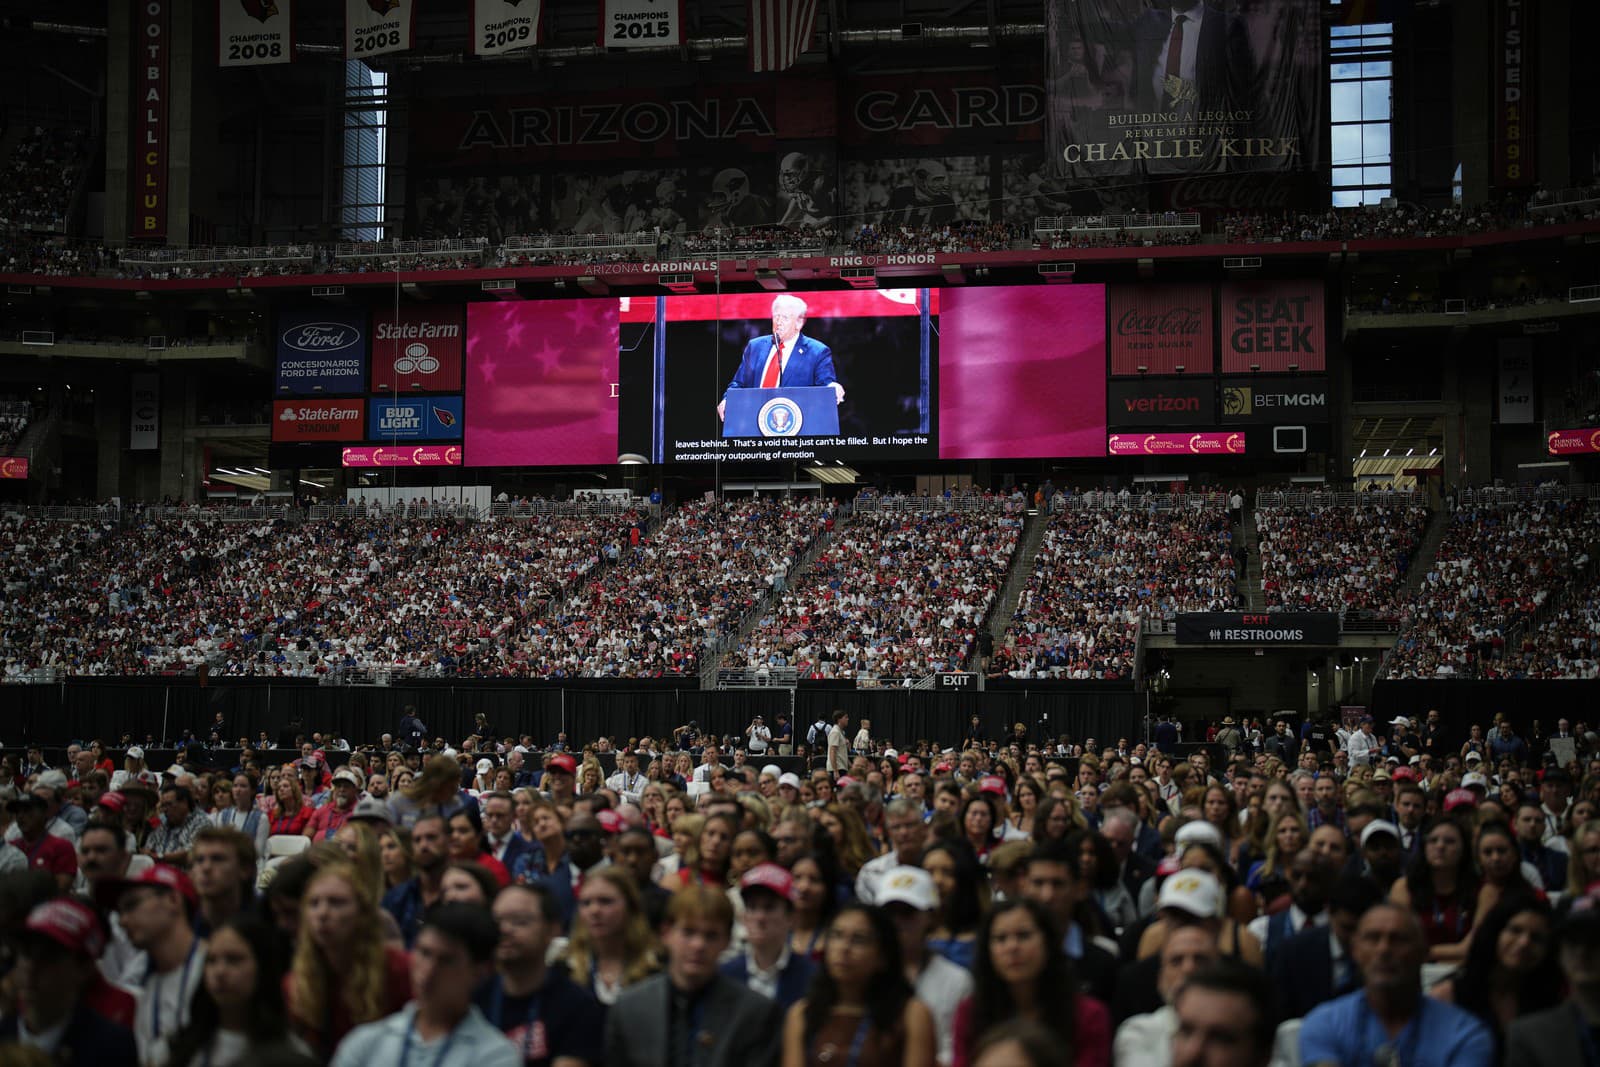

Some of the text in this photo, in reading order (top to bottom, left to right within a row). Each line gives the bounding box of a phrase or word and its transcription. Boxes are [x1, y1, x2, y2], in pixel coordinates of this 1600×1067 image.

[614, 12, 669, 20] CHAMPIONS
[355, 21, 400, 35] CHAMPIONS
[484, 17, 531, 32] CHAMPIONS
[613, 21, 670, 39] 2015
[229, 33, 281, 43] CHAMPIONS
[354, 30, 400, 52] 2008
[484, 26, 530, 49] 2009
[228, 43, 281, 59] 2008
[456, 97, 776, 150] ARIZONA
[1109, 110, 1255, 126] BUILDING A LEGACY
[1125, 127, 1235, 138] REMEMBERING
[1505, 103, 1521, 179] 1898
[1063, 136, 1301, 164] CHARLIE KIRK
[144, 151, 159, 230] CLUB
[830, 254, 936, 267] RING OF HONOR
[584, 261, 718, 275] ARIZONA CARDINALS
[1235, 296, 1310, 324] SEAT
[297, 326, 345, 347] Ford
[1231, 325, 1314, 353] GEEK
[281, 359, 360, 370] CONCESIONARIOS
[281, 367, 360, 377] FORD DE ARIZONA
[1125, 393, 1200, 413] verizon
[1254, 393, 1325, 407] BETMGM
[385, 407, 415, 418] BUD
[297, 423, 340, 433] STADIUM
[379, 417, 420, 429] LIGHT
[675, 440, 700, 448] leaves
[700, 439, 730, 448] behind.
[733, 439, 756, 447] That's
[764, 438, 781, 446] void
[782, 438, 798, 446] that
[798, 438, 814, 448] just
[815, 438, 834, 446] can't
[835, 437, 846, 446] be
[847, 437, 869, 446] filled.
[872, 437, 887, 445] But
[892, 436, 913, 446] hope
[914, 436, 928, 444] the
[675, 450, 815, 461] extraordinary outpouring of emotion
[1242, 615, 1270, 625] EXIT
[1225, 629, 1304, 641] RESTROOMS
[943, 675, 970, 686] EXIT
